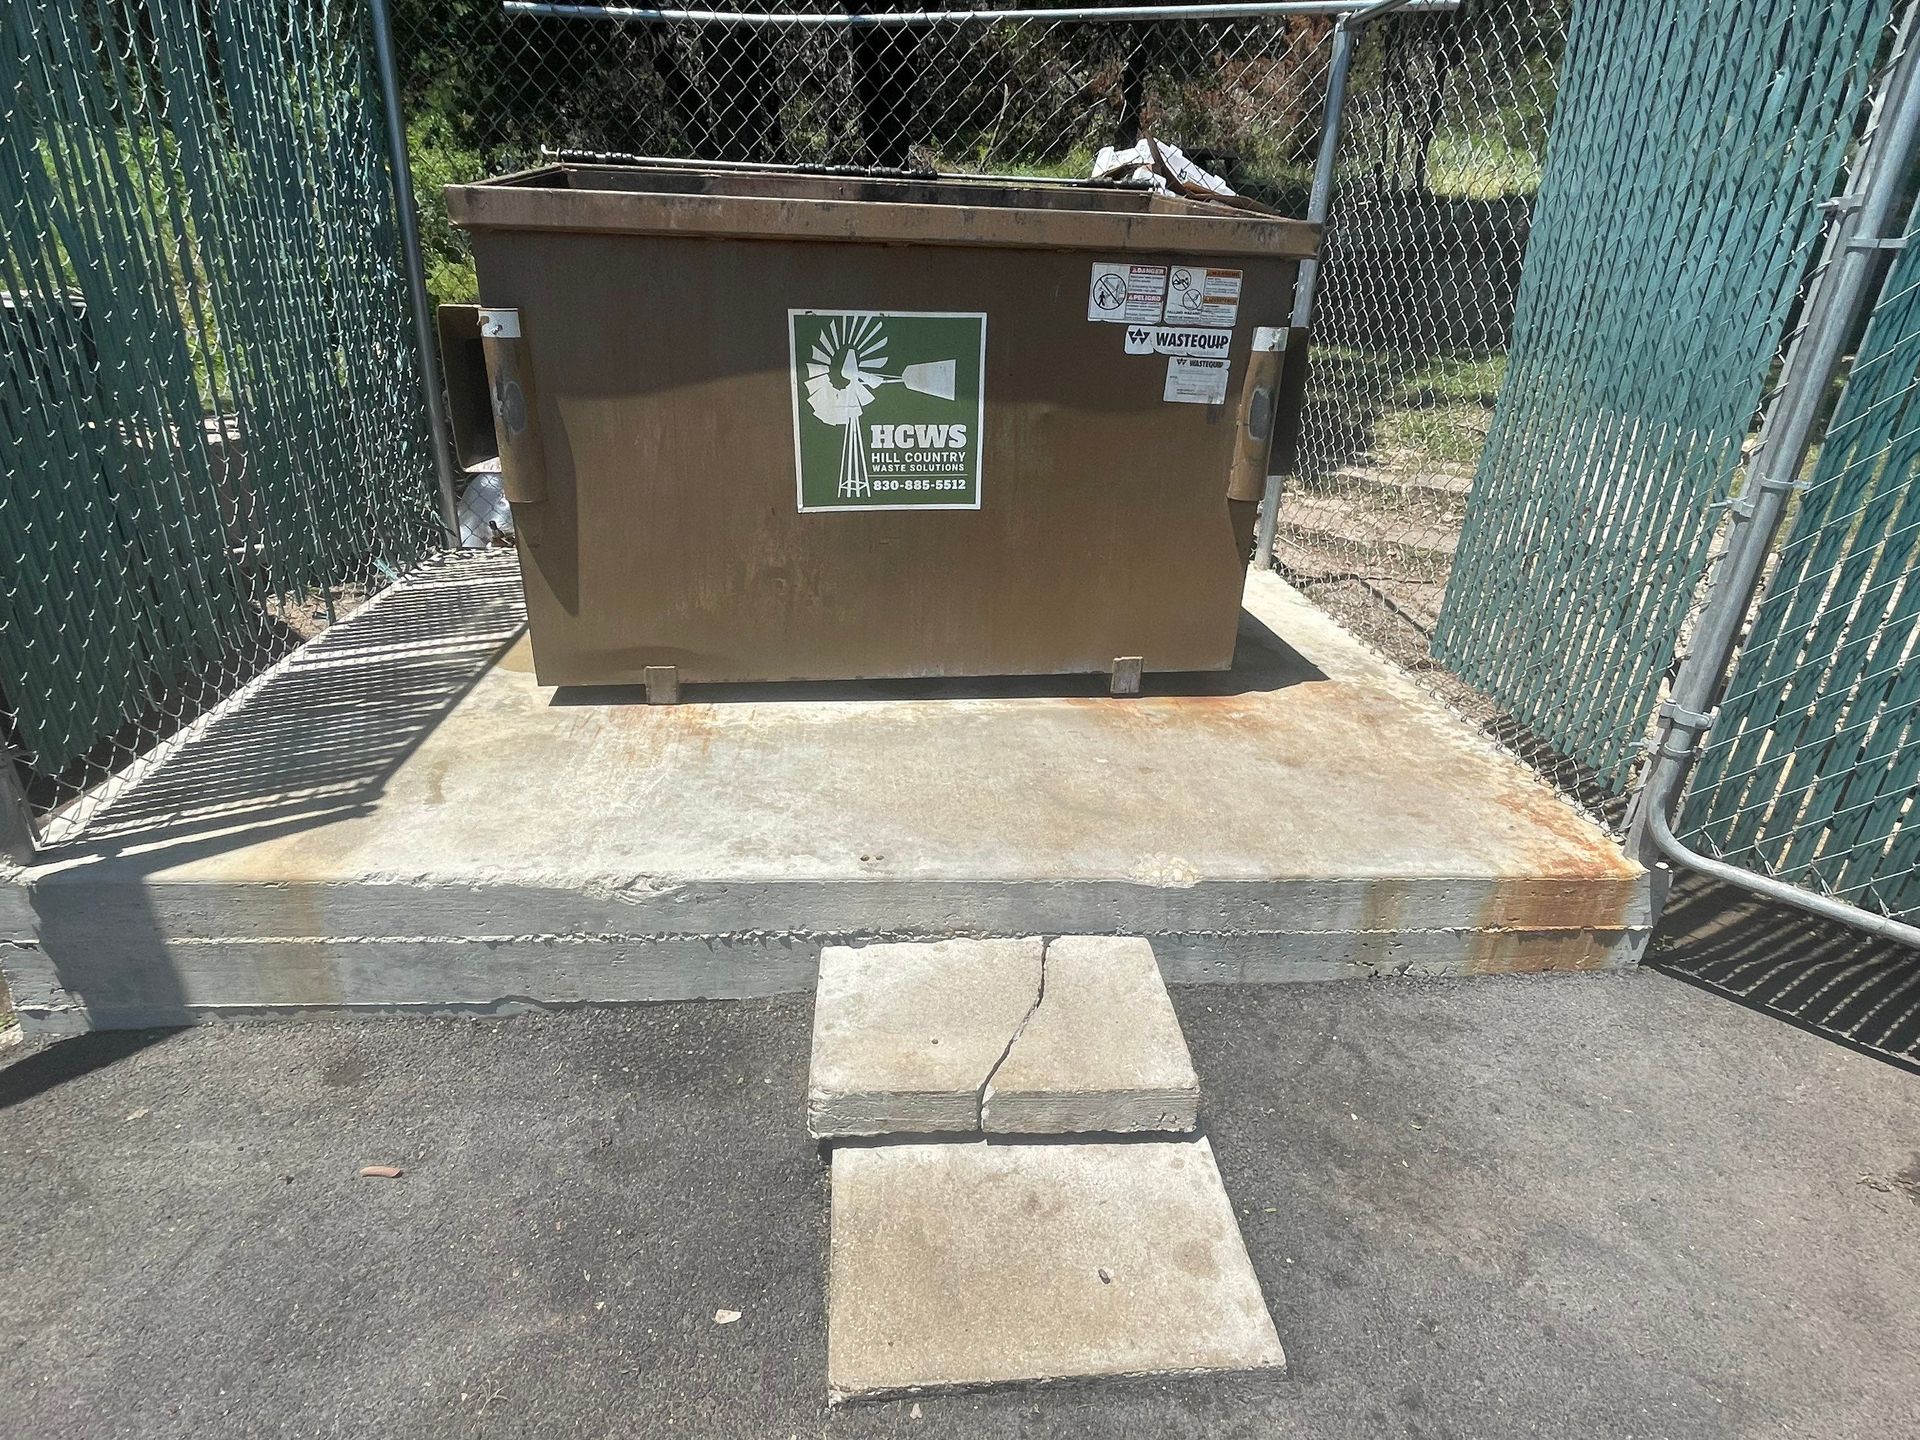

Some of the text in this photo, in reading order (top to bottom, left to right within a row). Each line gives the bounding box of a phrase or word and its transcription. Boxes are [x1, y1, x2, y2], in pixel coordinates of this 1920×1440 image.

[1156, 332, 1229, 349] WASTEQUIP
[1190, 359, 1224, 368] WASTEQUIP
[870, 424, 967, 449] HCWS
[871, 452, 966, 463] HILL COUNTRY
[872, 463, 965, 472] WASTE SOLUTIONS
[873, 479, 966, 491] 830-885-5512
